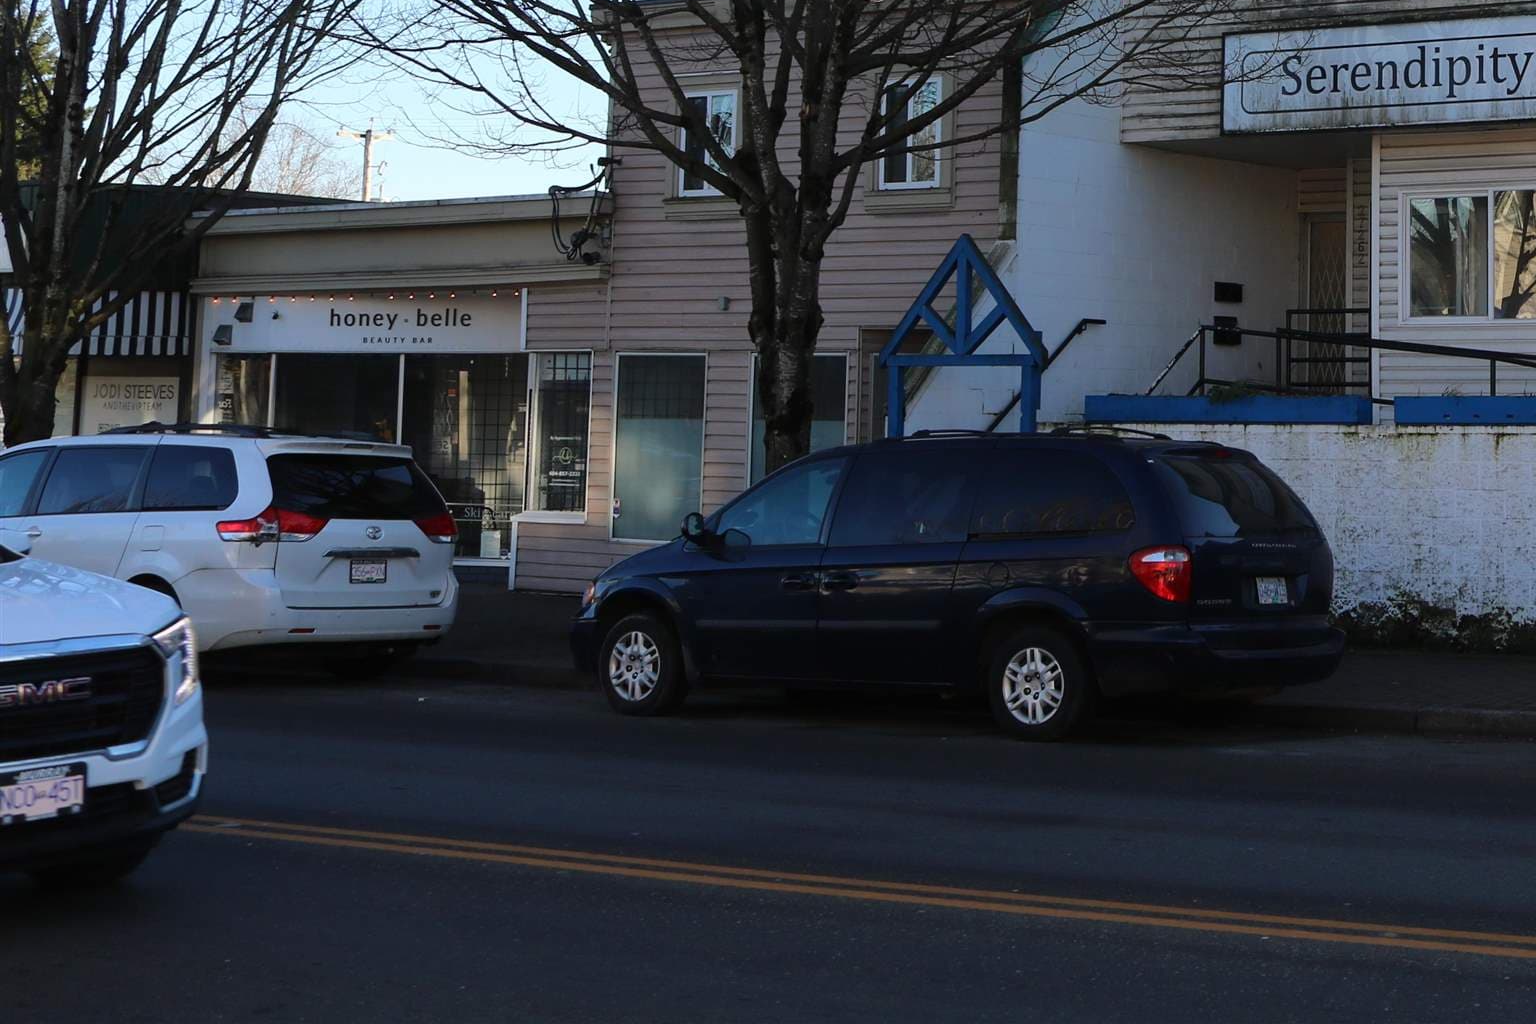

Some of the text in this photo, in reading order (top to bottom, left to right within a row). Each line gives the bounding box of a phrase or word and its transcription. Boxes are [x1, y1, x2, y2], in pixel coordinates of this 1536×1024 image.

[1280, 42, 1533, 97] Serendipity
[329, 308, 472, 330] honey belle
[362, 336, 434, 344] BEAUTY BAR
[94, 383, 175, 400] JODI STEEVES
[0, 676, 92, 708] GMC
